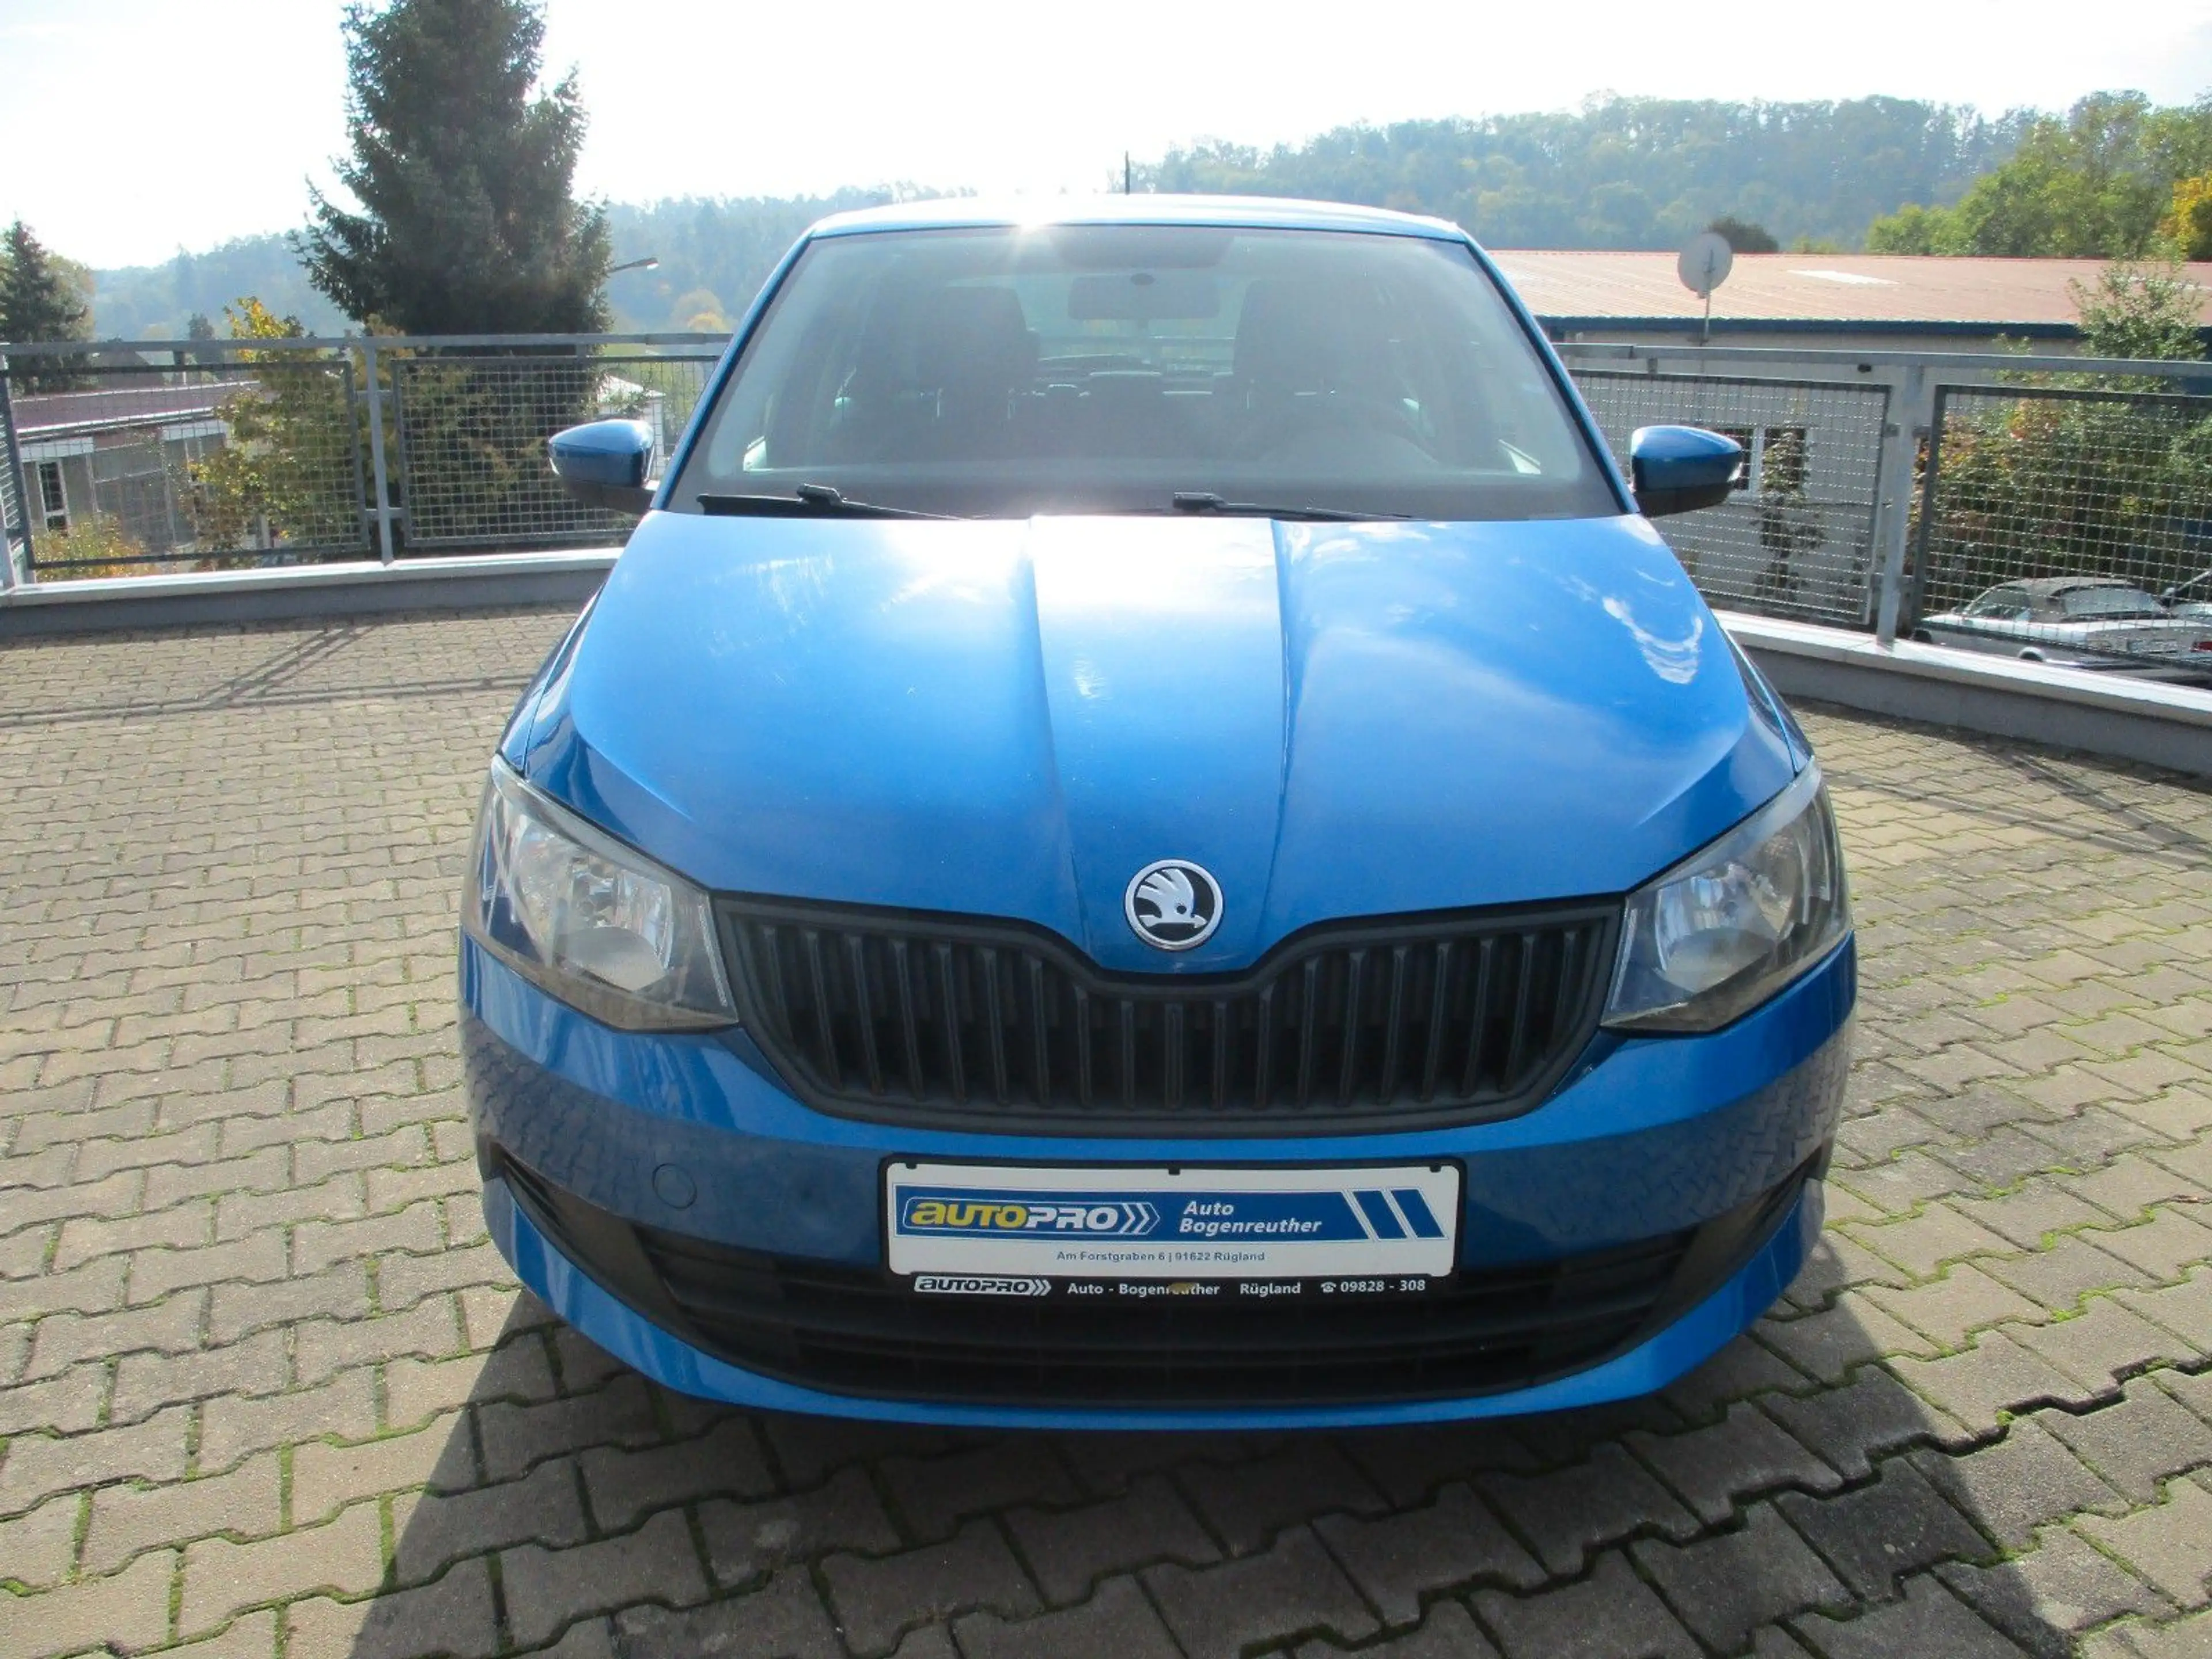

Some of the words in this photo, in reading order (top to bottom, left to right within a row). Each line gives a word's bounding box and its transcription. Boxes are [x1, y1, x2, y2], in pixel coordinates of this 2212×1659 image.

[1183, 1200, 1234, 1215] Auto
[1179, 1218, 1322, 1237] Bogenreuther
[1056, 1251, 1077, 1260] Am
[1080, 1251, 1154, 1262] Forstgraben
[1158, 1252, 1165, 1260] 6
[1214, 1252, 1264, 1263] Rügland
[1067, 1283, 1104, 1294] Auto
[1240, 1283, 1301, 1297] Rügland
[1340, 1281, 1384, 1292] 09828
[1399, 1279, 1425, 1291] 308
